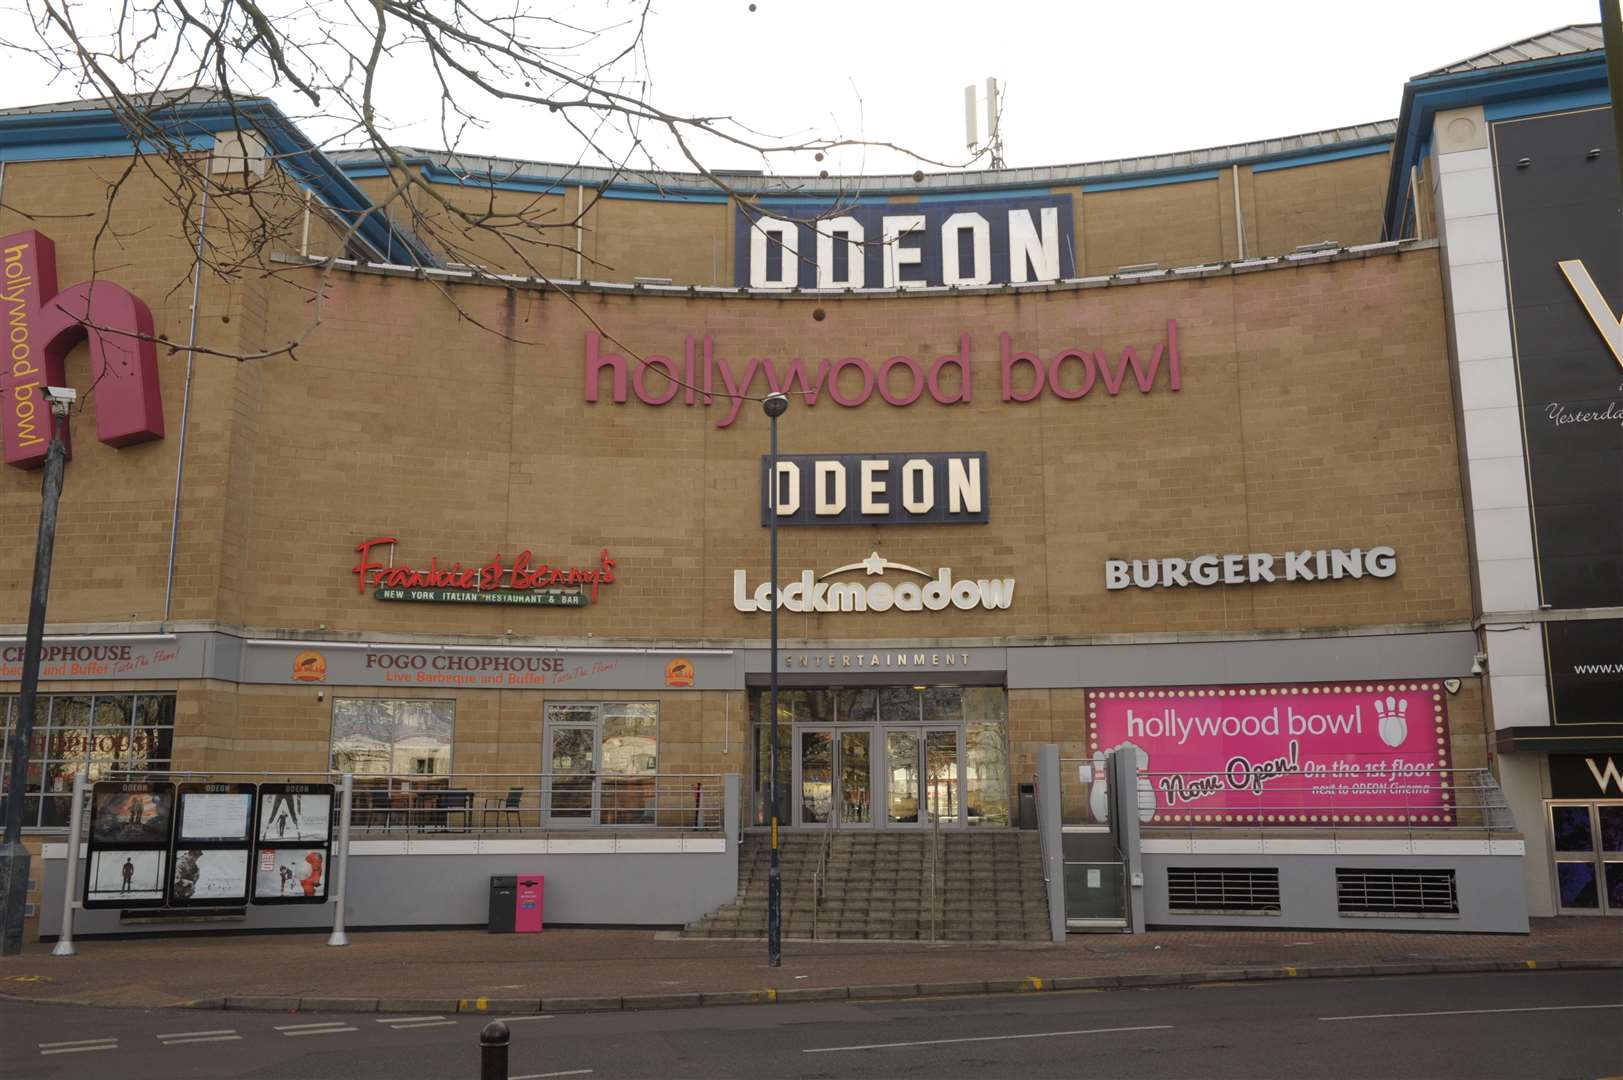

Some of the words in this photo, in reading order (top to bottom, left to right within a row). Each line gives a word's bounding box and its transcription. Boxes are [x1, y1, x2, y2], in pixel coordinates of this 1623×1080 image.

[750, 207, 1060, 289] ODEON
[1, 243, 39, 377] hollywood
[584, 331, 972, 428] hollywood
[1001, 319, 1182, 402] bowl
[15, 382, 44, 447] bowl
[1545, 401, 1623, 427] Yesterda
[768, 457, 981, 516] ODEON
[1105, 552, 1276, 590] BURGER
[1284, 546, 1397, 581] KING
[383, 590, 404, 600] NEW
[411, 591, 434, 600] YORK
[442, 592, 478, 601] ITALIAN
[485, 594, 541, 604] RESTAURANT
[548, 596, 555, 604] &
[561, 596, 579, 604] BAR
[733, 567, 1016, 612] Lockmeadow
[71, 660, 108, 676] Buffet
[366, 653, 427, 670] FOGO
[431, 655, 564, 673] CHOPHOUSE
[385, 671, 412, 682] Live
[416, 671, 476, 687] Barbeque
[480, 674, 503, 684] and
[508, 672, 545, 685] Buffet
[784, 653, 970, 668] ENTERTAINMENT
[1127, 707, 1280, 745] hollywood
[1288, 705, 1362, 735] bowl
[1159, 774, 1225, 806] Now
[1224, 739, 1299, 796] Open!
[1303, 761, 1326, 778] On
[1331, 760, 1360, 778] the
[1365, 760, 1387, 778] 1st
[1388, 759, 1434, 782] floor
[1312, 785, 1335, 795] next
[1339, 783, 1349, 795] to
[1352, 783, 1387, 795] ODEON
[1390, 783, 1430, 795] Cinema
